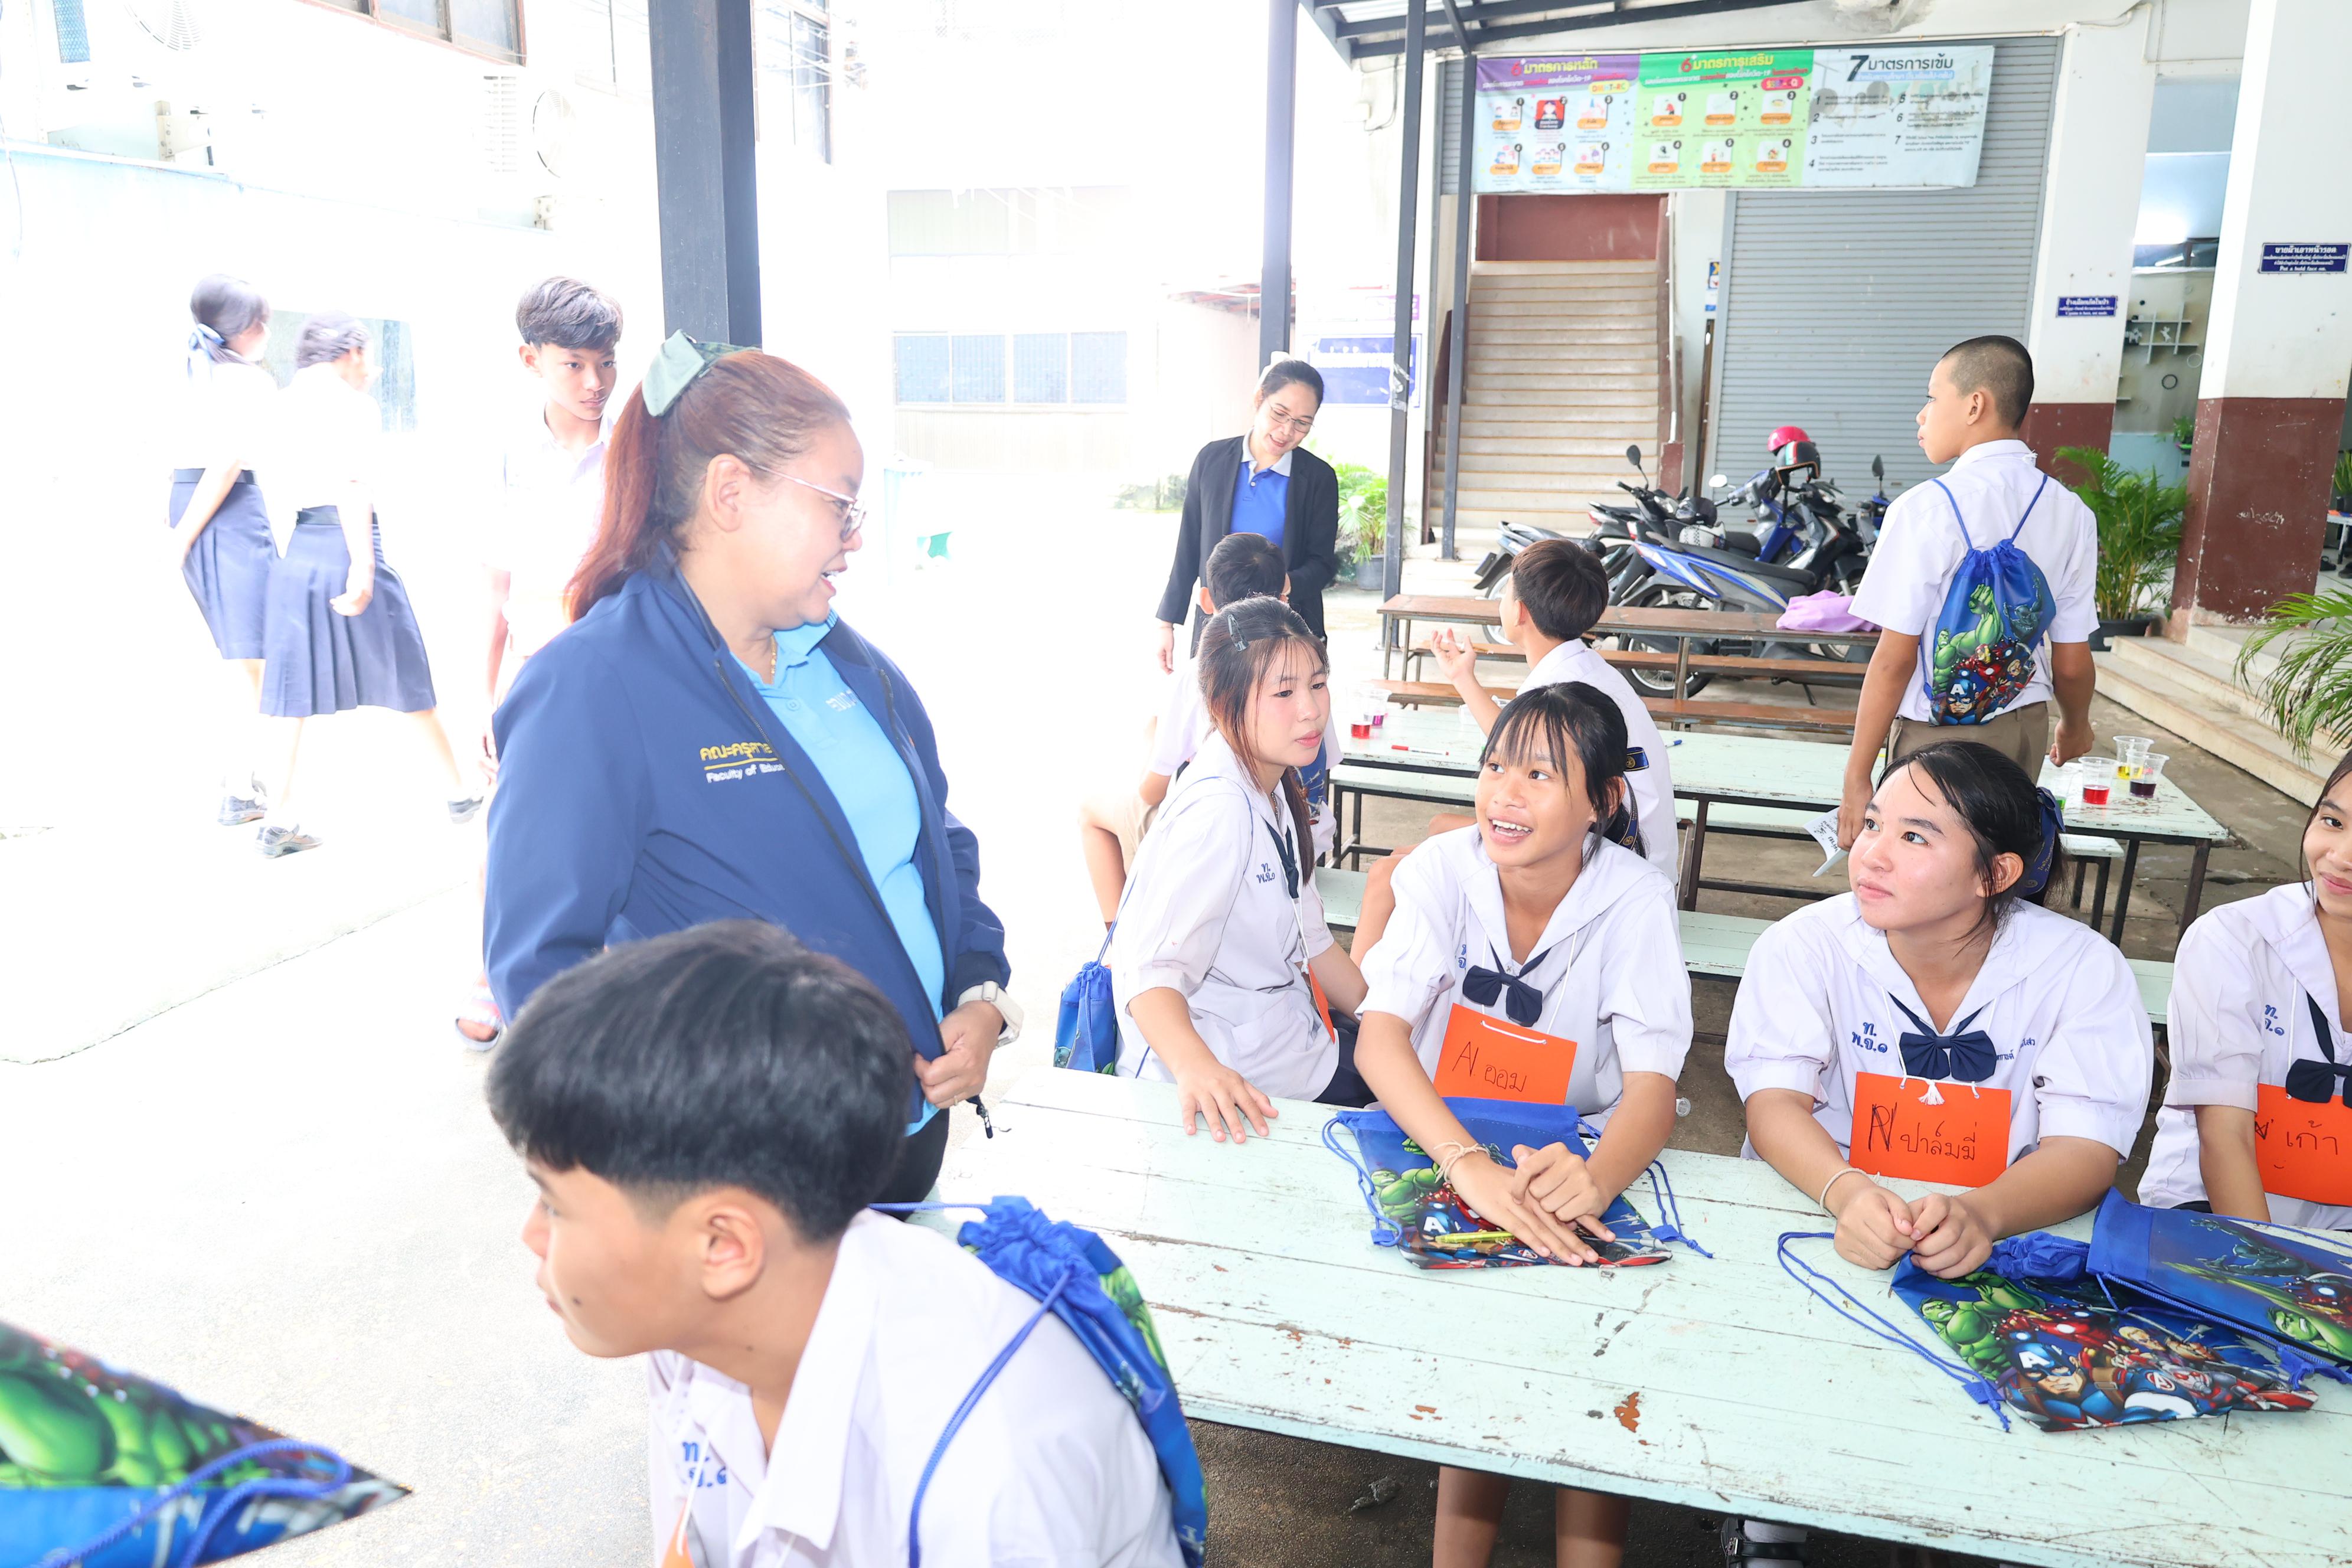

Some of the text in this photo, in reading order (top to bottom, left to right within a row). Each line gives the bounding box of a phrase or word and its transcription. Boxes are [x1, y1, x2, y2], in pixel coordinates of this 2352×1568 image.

[1847, 55, 1870, 81] 7
[1868, 53, 1954, 70] มาตรการเข้ม
[1813, 113, 1819, 122] 2
[1896, 113, 1903, 122] 6
[1811, 135, 1817, 144] 3
[1808, 159, 1815, 168] 4
[706, 769, 743, 784] Faculty
[745, 764, 757, 776] of
[1484, 1064, 1527, 1092] ออม
[1900, 1121, 1977, 1161] ปาล์มมี่
[2286, 1120, 2338, 1155] เก้า
